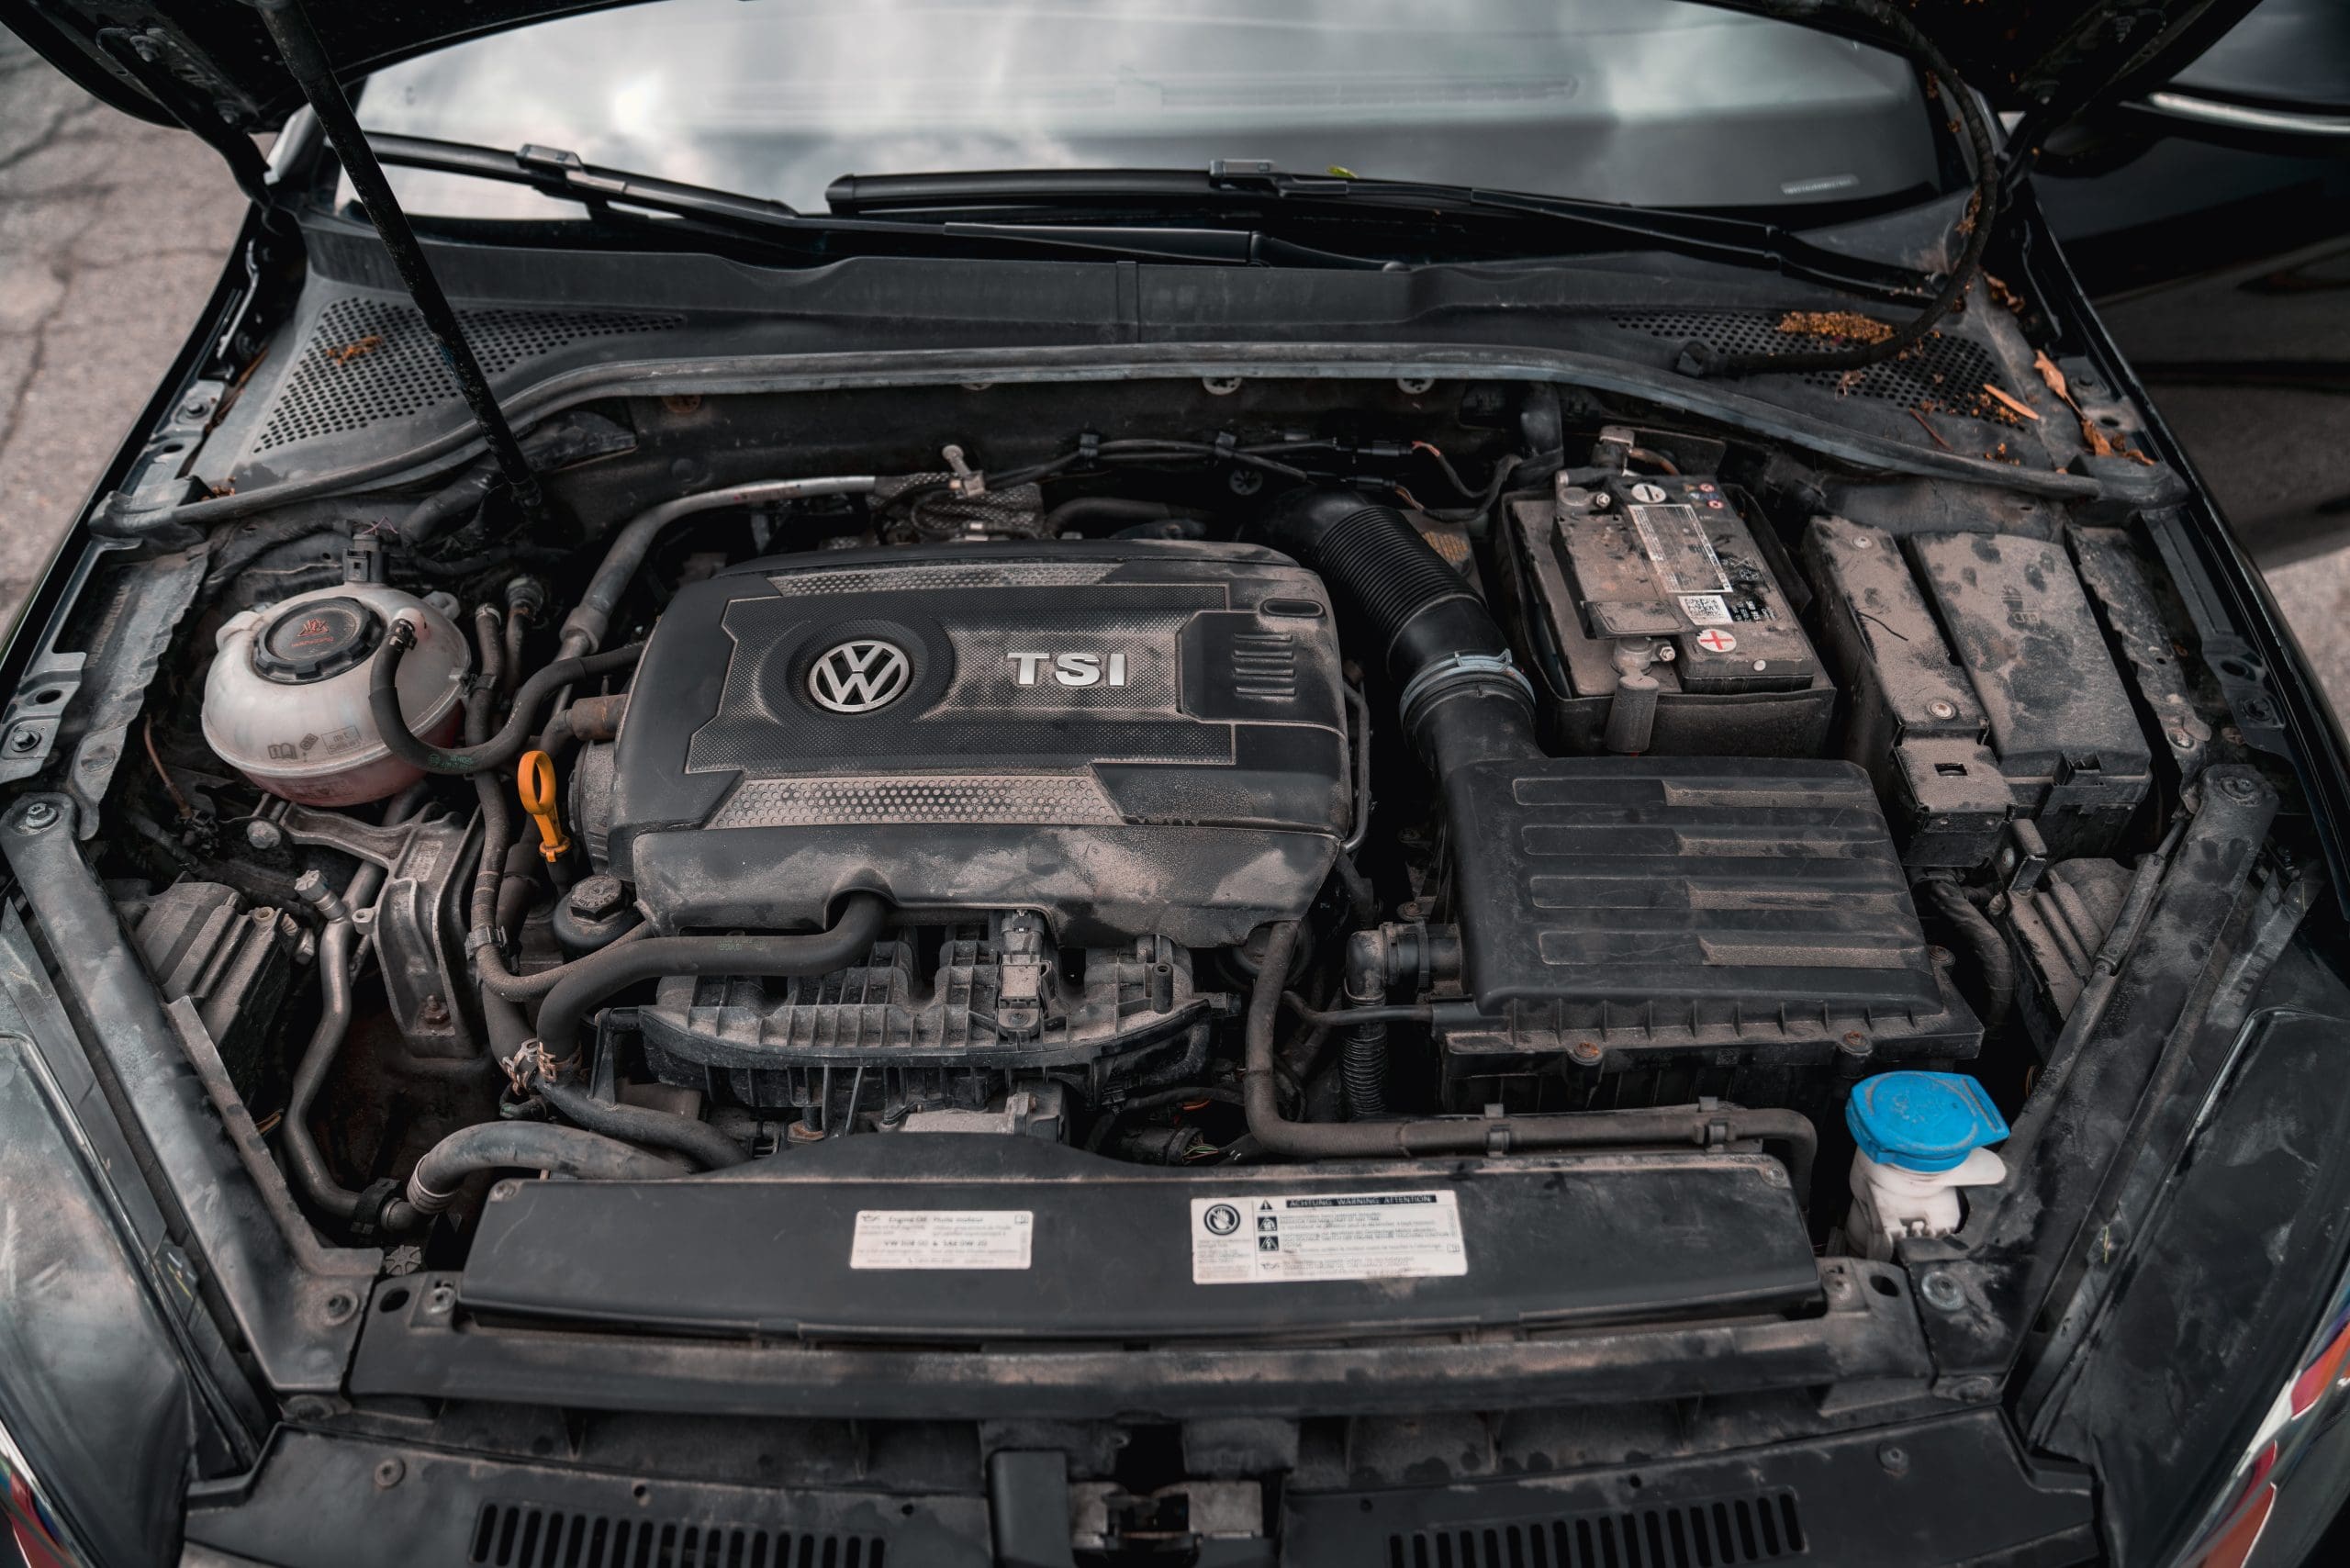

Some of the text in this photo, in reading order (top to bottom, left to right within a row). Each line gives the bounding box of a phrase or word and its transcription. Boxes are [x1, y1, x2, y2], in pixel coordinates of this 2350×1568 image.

[809, 640, 910, 712] VW
[1006, 653, 1125, 687] TSI
[1337, 1197, 1380, 1205] WARNING
[1384, 1195, 1431, 1204] ATTENTION
